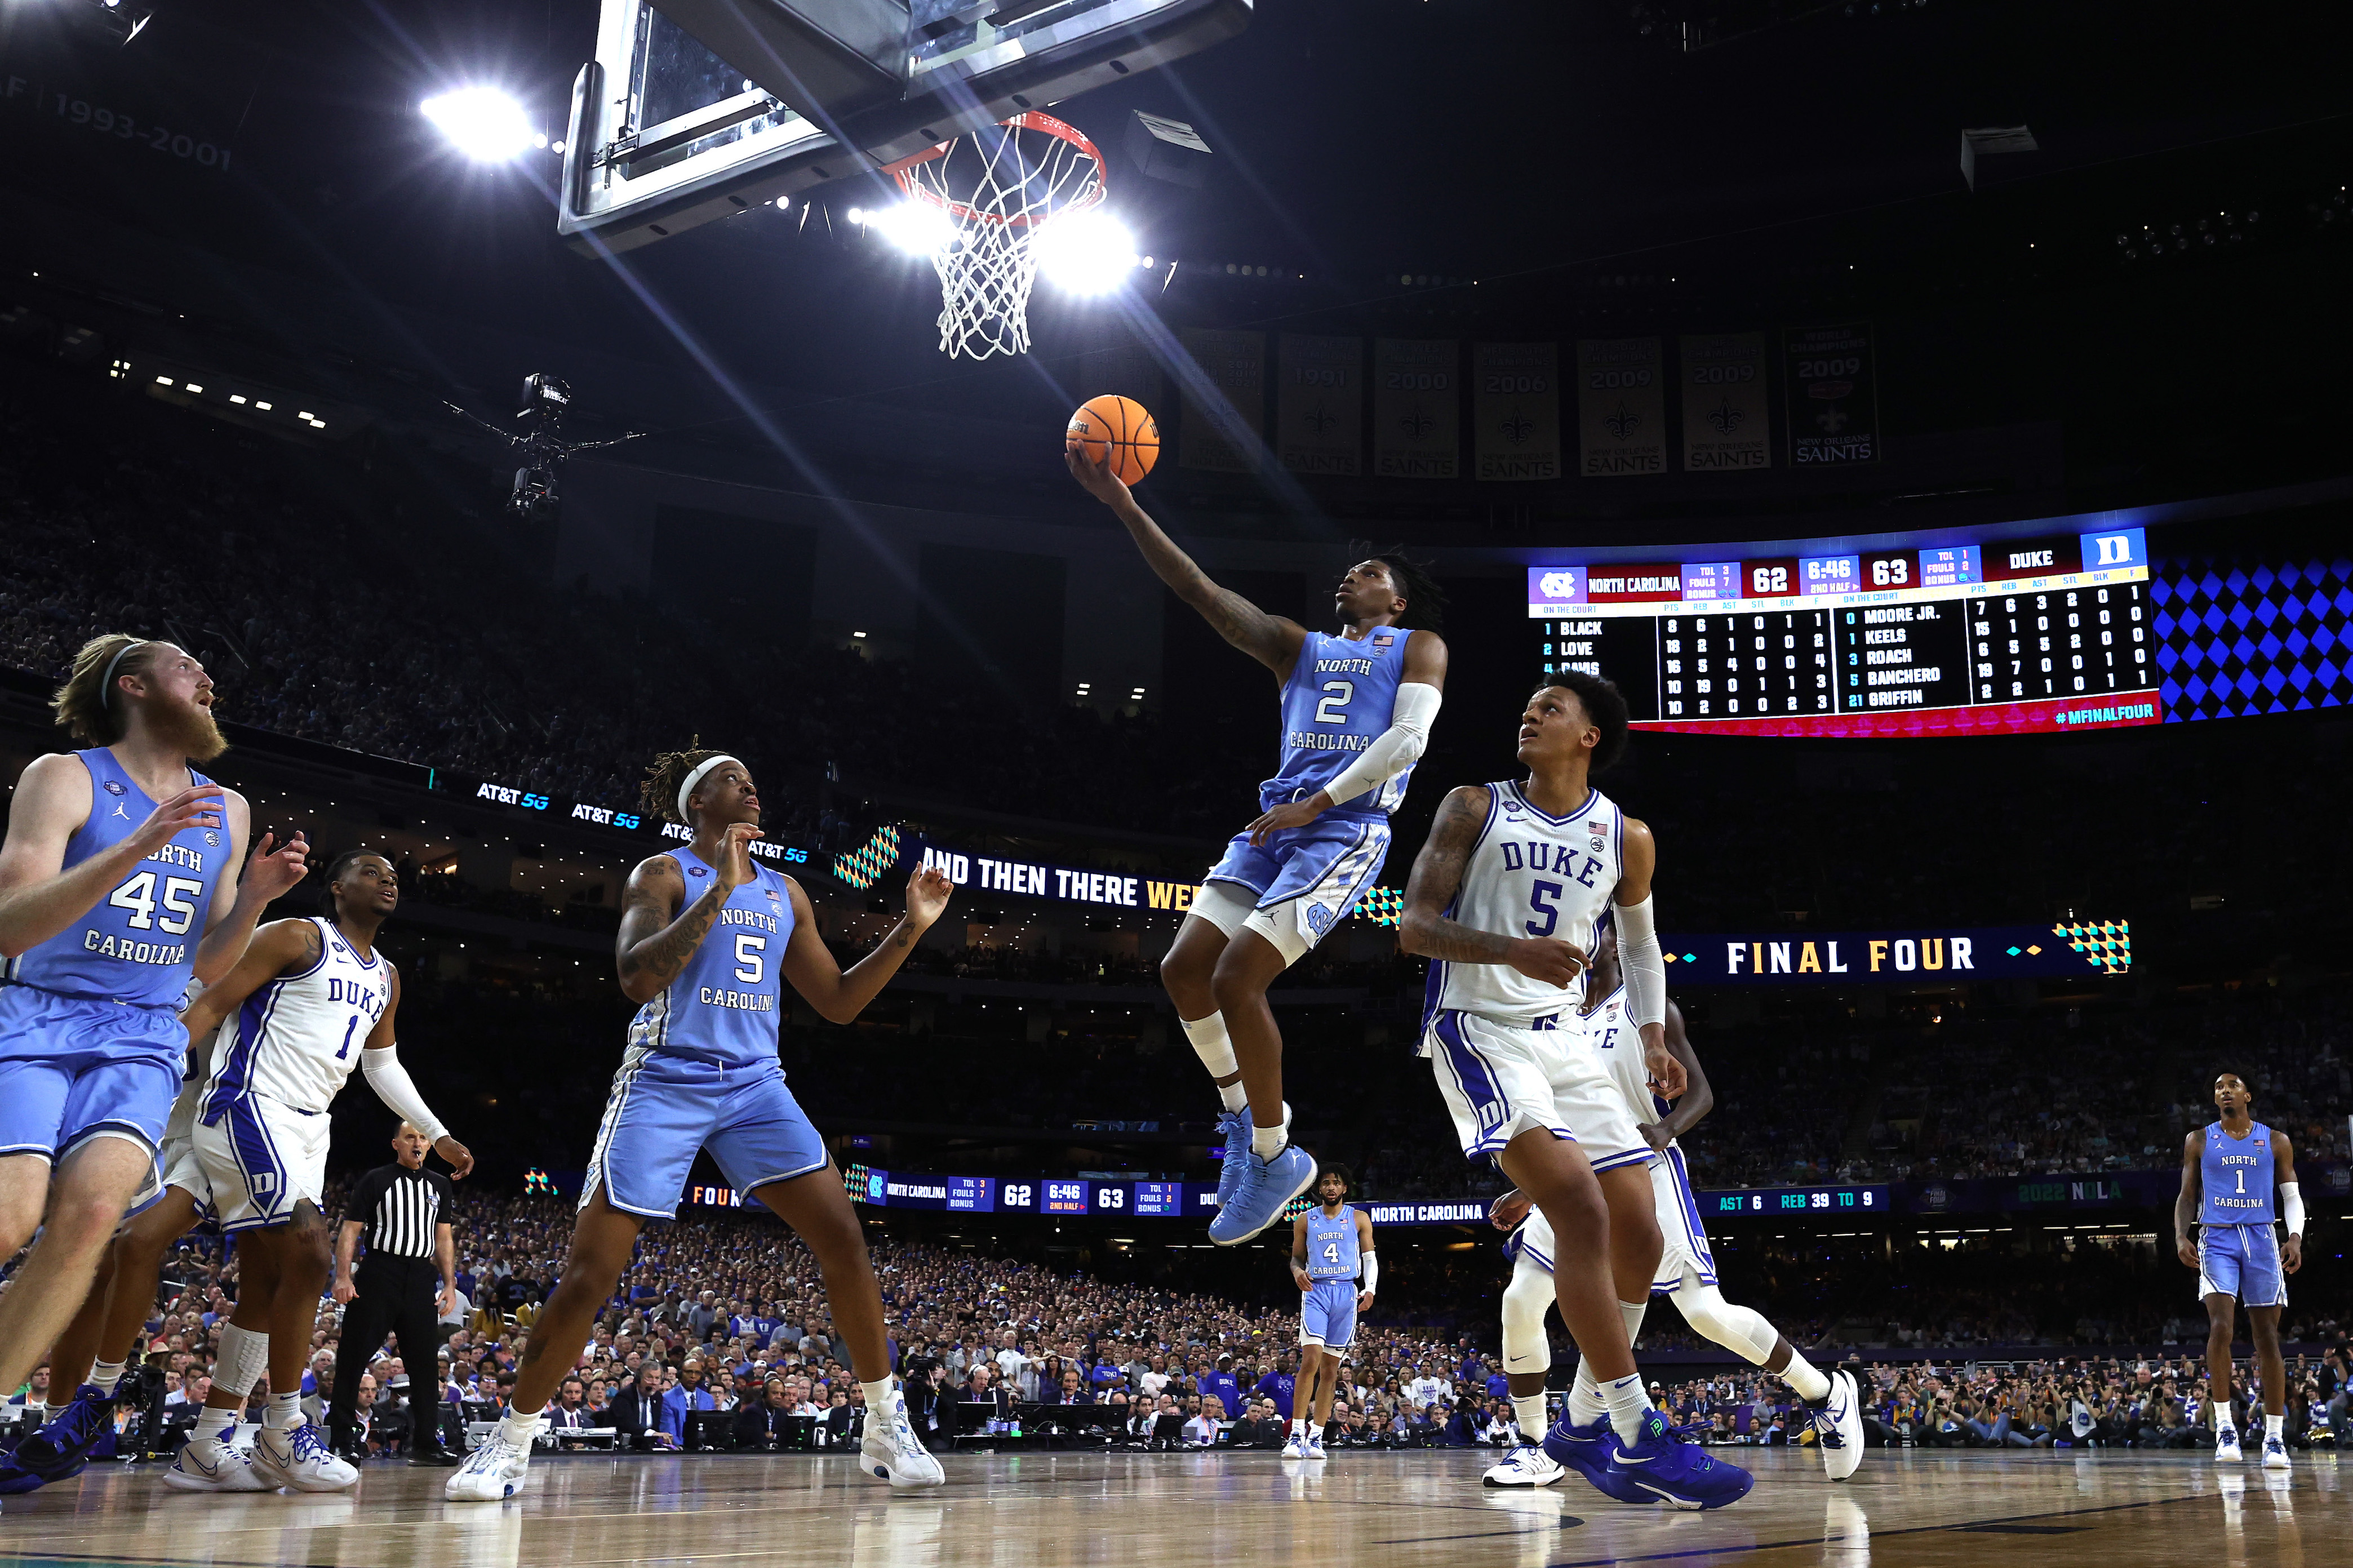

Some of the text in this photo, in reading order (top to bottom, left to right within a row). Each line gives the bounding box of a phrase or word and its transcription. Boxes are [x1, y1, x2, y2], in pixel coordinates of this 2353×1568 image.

[1693, 365, 1755, 384] 2009
[1799, 357, 1860, 377] 2009
[1590, 369, 1652, 389] 2009
[1691, 451, 1765, 467] SAINTS
[1797, 443, 1871, 462] SAINTS
[1938, 549, 1968, 561] TOL 1
[2009, 550, 2054, 569] DUKE
[1723, 565, 1729, 575] 3
[1808, 559, 1851, 580] 6:46
[1872, 558, 1908, 586] 63
[1926, 562, 1955, 574] FOULS
[1588, 576, 1681, 593] NORTH CAROLINA
[1689, 576, 1730, 588] FOULS 7
[1753, 567, 1787, 593] 62
[1810, 582, 1850, 594] 2ND HALF
[1873, 592, 1899, 601] COURT
[2063, 575, 2079, 584] STL
[2093, 572, 2109, 581] BLK
[1925, 574, 1956, 585] BONUS
[1686, 589, 1716, 599] BONUS
[1846, 585, 2138, 624] 0 MOORE JR. 7 6 3 2 0 1
[1546, 613, 1821, 635] 1 BLACK 8 6 1 0 1 1
[1850, 628, 1906, 645] 1 KEELS
[1544, 642, 1593, 655] 2 LOVE
[1849, 648, 1912, 665] 3 ROACH
[1314, 658, 1373, 676] NORTH
[1850, 667, 1941, 686] 5 BANCHERO
[1313, 680, 1354, 725] 2
[1849, 689, 1923, 707] 21 GRIFFIN
[1290, 731, 1370, 751] CAROLINA
[477, 783, 549, 810] AT&T 5G
[571, 803, 640, 829] AT&T 5G
[661, 823, 694, 841] AT&
[748, 840, 808, 863] AT&T 5G
[1500, 842, 1603, 889] DUKE
[922, 847, 969, 884] AND
[978, 859, 1046, 895] THEN
[1055, 869, 1138, 906] THERE
[109, 870, 203, 935] 45
[1526, 879, 1563, 936] 5
[721, 908, 777, 935] NORTH
[84, 929, 185, 965] CAROLINA
[1727, 938, 1974, 974] FINAL FOUR
[734, 933, 766, 984] 5
[328, 978, 384, 1024] DUKE
[335, 1015, 358, 1060] 1
[2221, 1155, 2257, 1166] NORTH
[252, 1172, 274, 1194] D
[886, 1183, 947, 1199] NORTH CAROLINA
[963, 1179, 975, 1188] TOL
[1149, 1184, 1162, 1193] TOL
[2018, 1180, 2123, 1202] 2022 NOLA
[2235, 1169, 2246, 1194] 1
[693, 1186, 740, 1207] FOUR
[953, 1189, 974, 1197] FOULS
[1004, 1184, 1031, 1206] 62
[1049, 1184, 1081, 1199] 6:46
[1099, 1188, 1124, 1208] 63
[1720, 1191, 1873, 1211] AST 6 REB 39 TO 9
[950, 1199, 974, 1208] BONUS
[1138, 1204, 1161, 1212] BONUS
[2214, 1196, 2263, 1208] CAROLINA
[1371, 1205, 1483, 1222] NORTH CAROLINA
[1317, 1232, 1344, 1242] NORTH
[1323, 1242, 1339, 1263] 4
[1313, 1265, 1351, 1274] CAROLINA
[1219, 1378, 1234, 1386] DUKE
